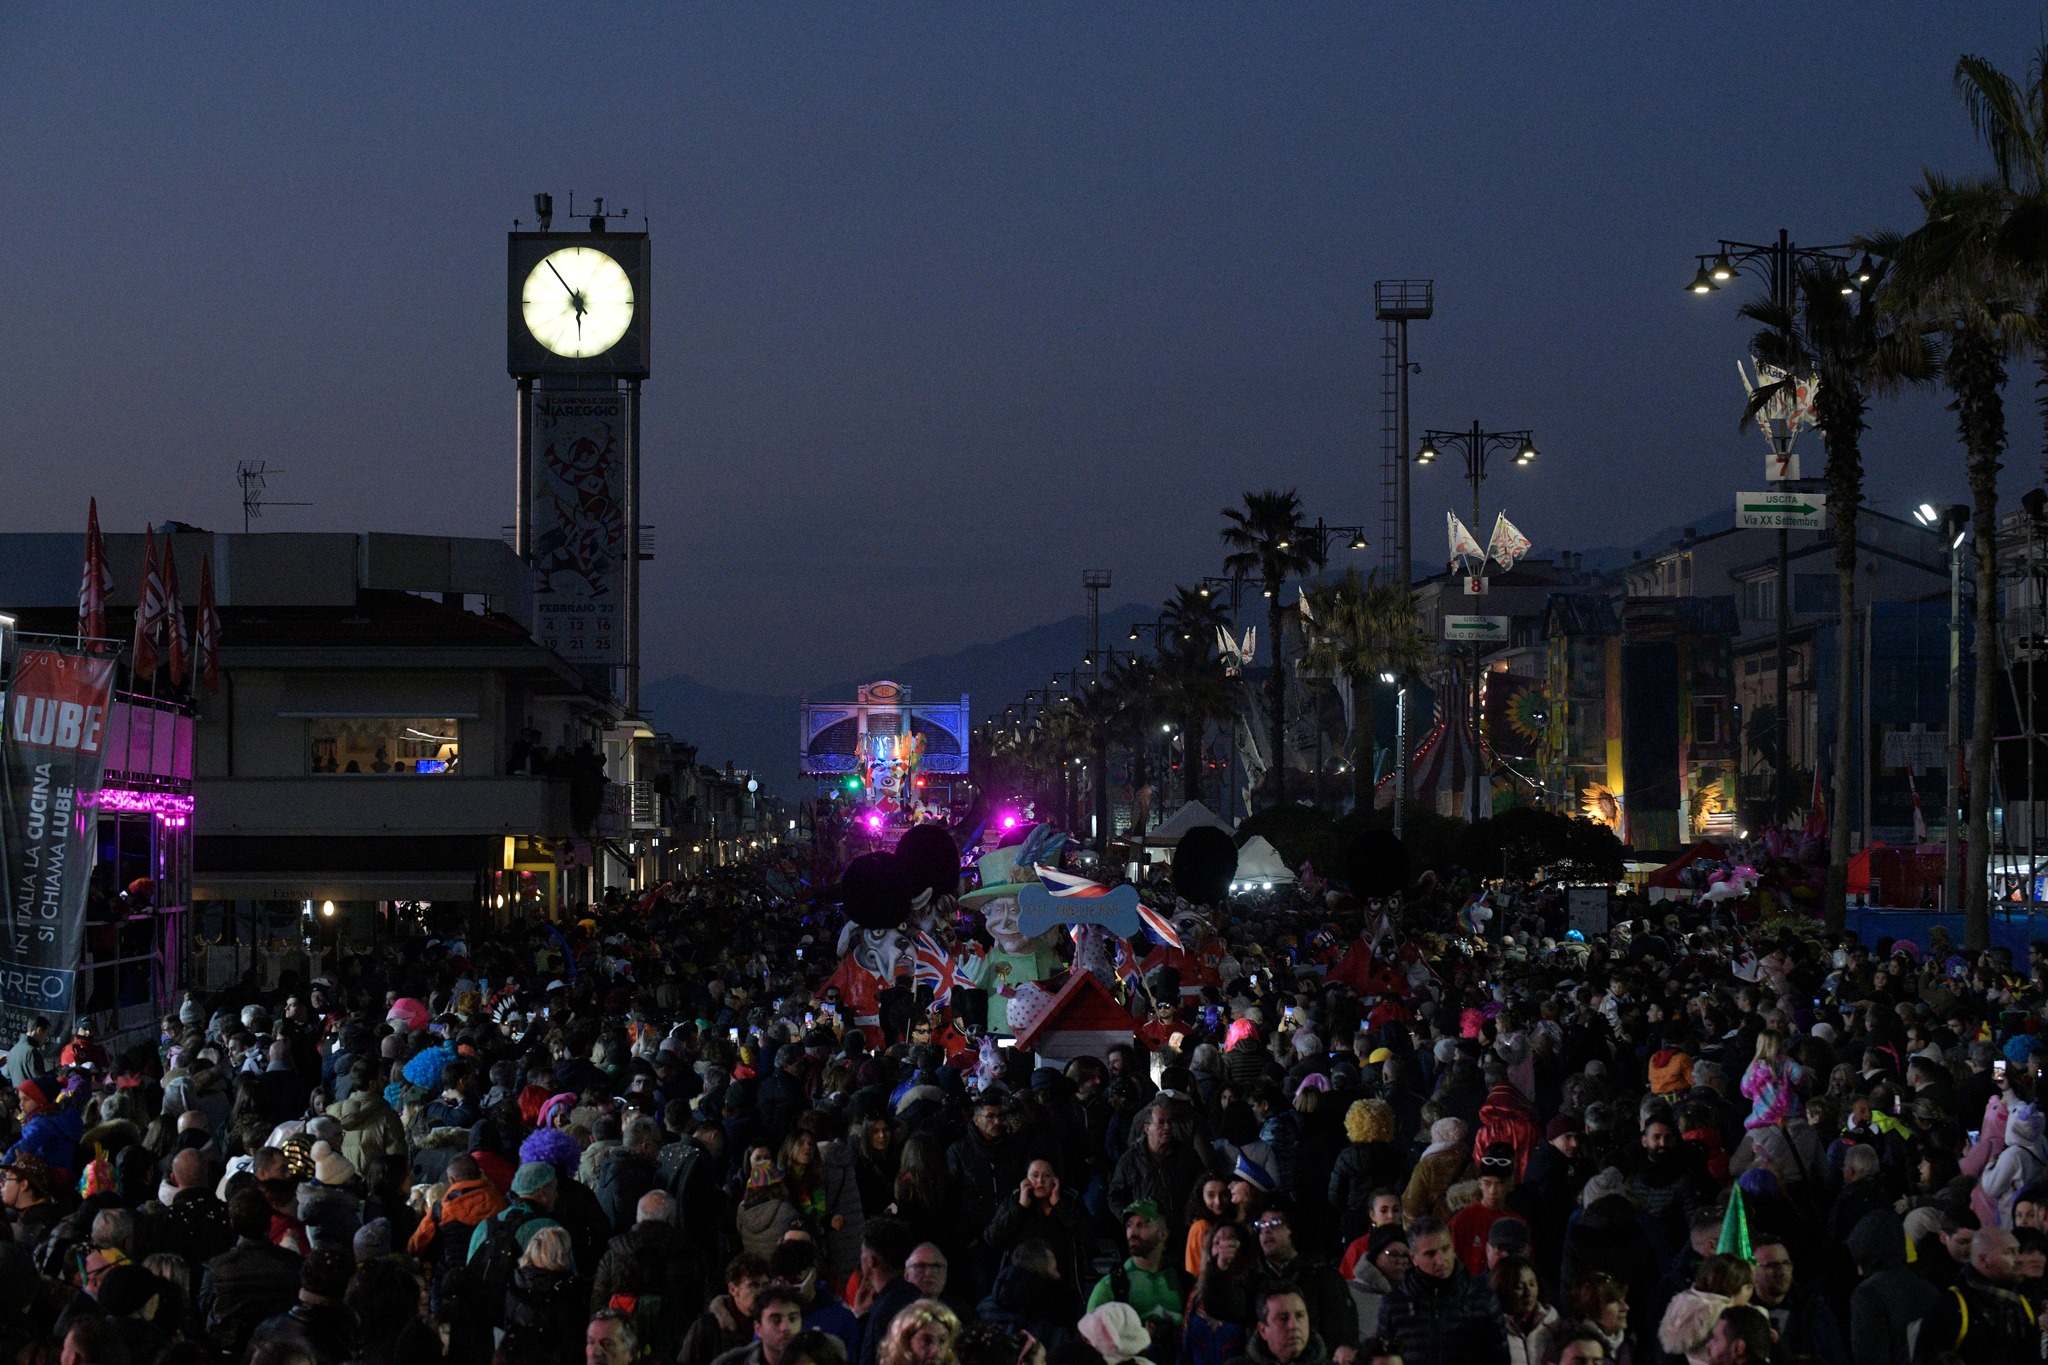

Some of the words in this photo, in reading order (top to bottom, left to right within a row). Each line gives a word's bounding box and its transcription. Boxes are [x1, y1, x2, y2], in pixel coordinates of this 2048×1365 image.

[1776, 458, 1789, 477] 7
[1766, 495, 1798, 504] USCITA
[1744, 515, 1758, 525] Via
[1760, 515, 1773, 525] XX
[1775, 515, 1819, 527] Settembre
[1471, 578, 1481, 593] 8
[539, 604, 596, 613] FEBBRAIO
[546, 621, 554, 631] 4
[570, 621, 584, 631] 12
[597, 621, 611, 631] 16
[544, 639, 558, 649] 19
[570, 639, 584, 649] 21
[595, 639, 611, 650] 25
[1468, 632, 1507, 640] D'Annunzio
[13, 695, 102, 751] LUBE
[27, 762, 52, 840] CUCINA
[51, 783, 75, 838] LUBE.
[24, 845, 42, 868] LA
[40, 842, 66, 920] CHIAMA
[17, 873, 37, 927] ITALIA
[38, 925, 55, 942] SI
[15, 933, 29, 955] IN
